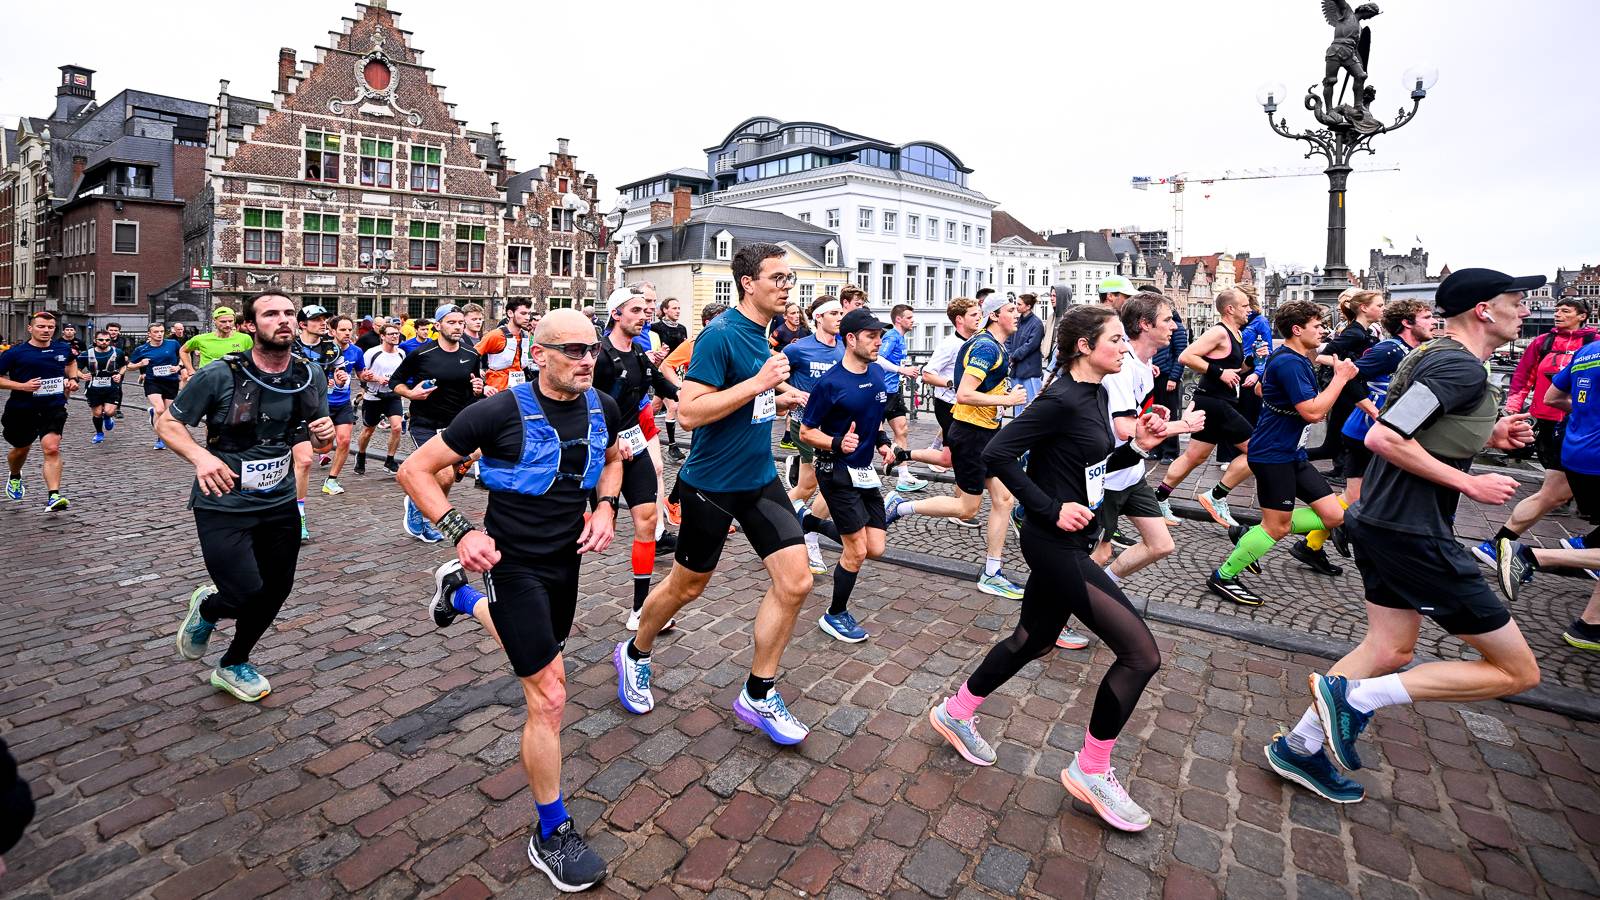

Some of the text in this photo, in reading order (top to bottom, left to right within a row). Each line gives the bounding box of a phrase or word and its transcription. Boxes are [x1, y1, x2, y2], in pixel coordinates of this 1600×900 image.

[810, 361, 836, 370] IRON
[1089, 464, 1106, 480] SOF
[1340, 711, 1350, 740] HOKA
